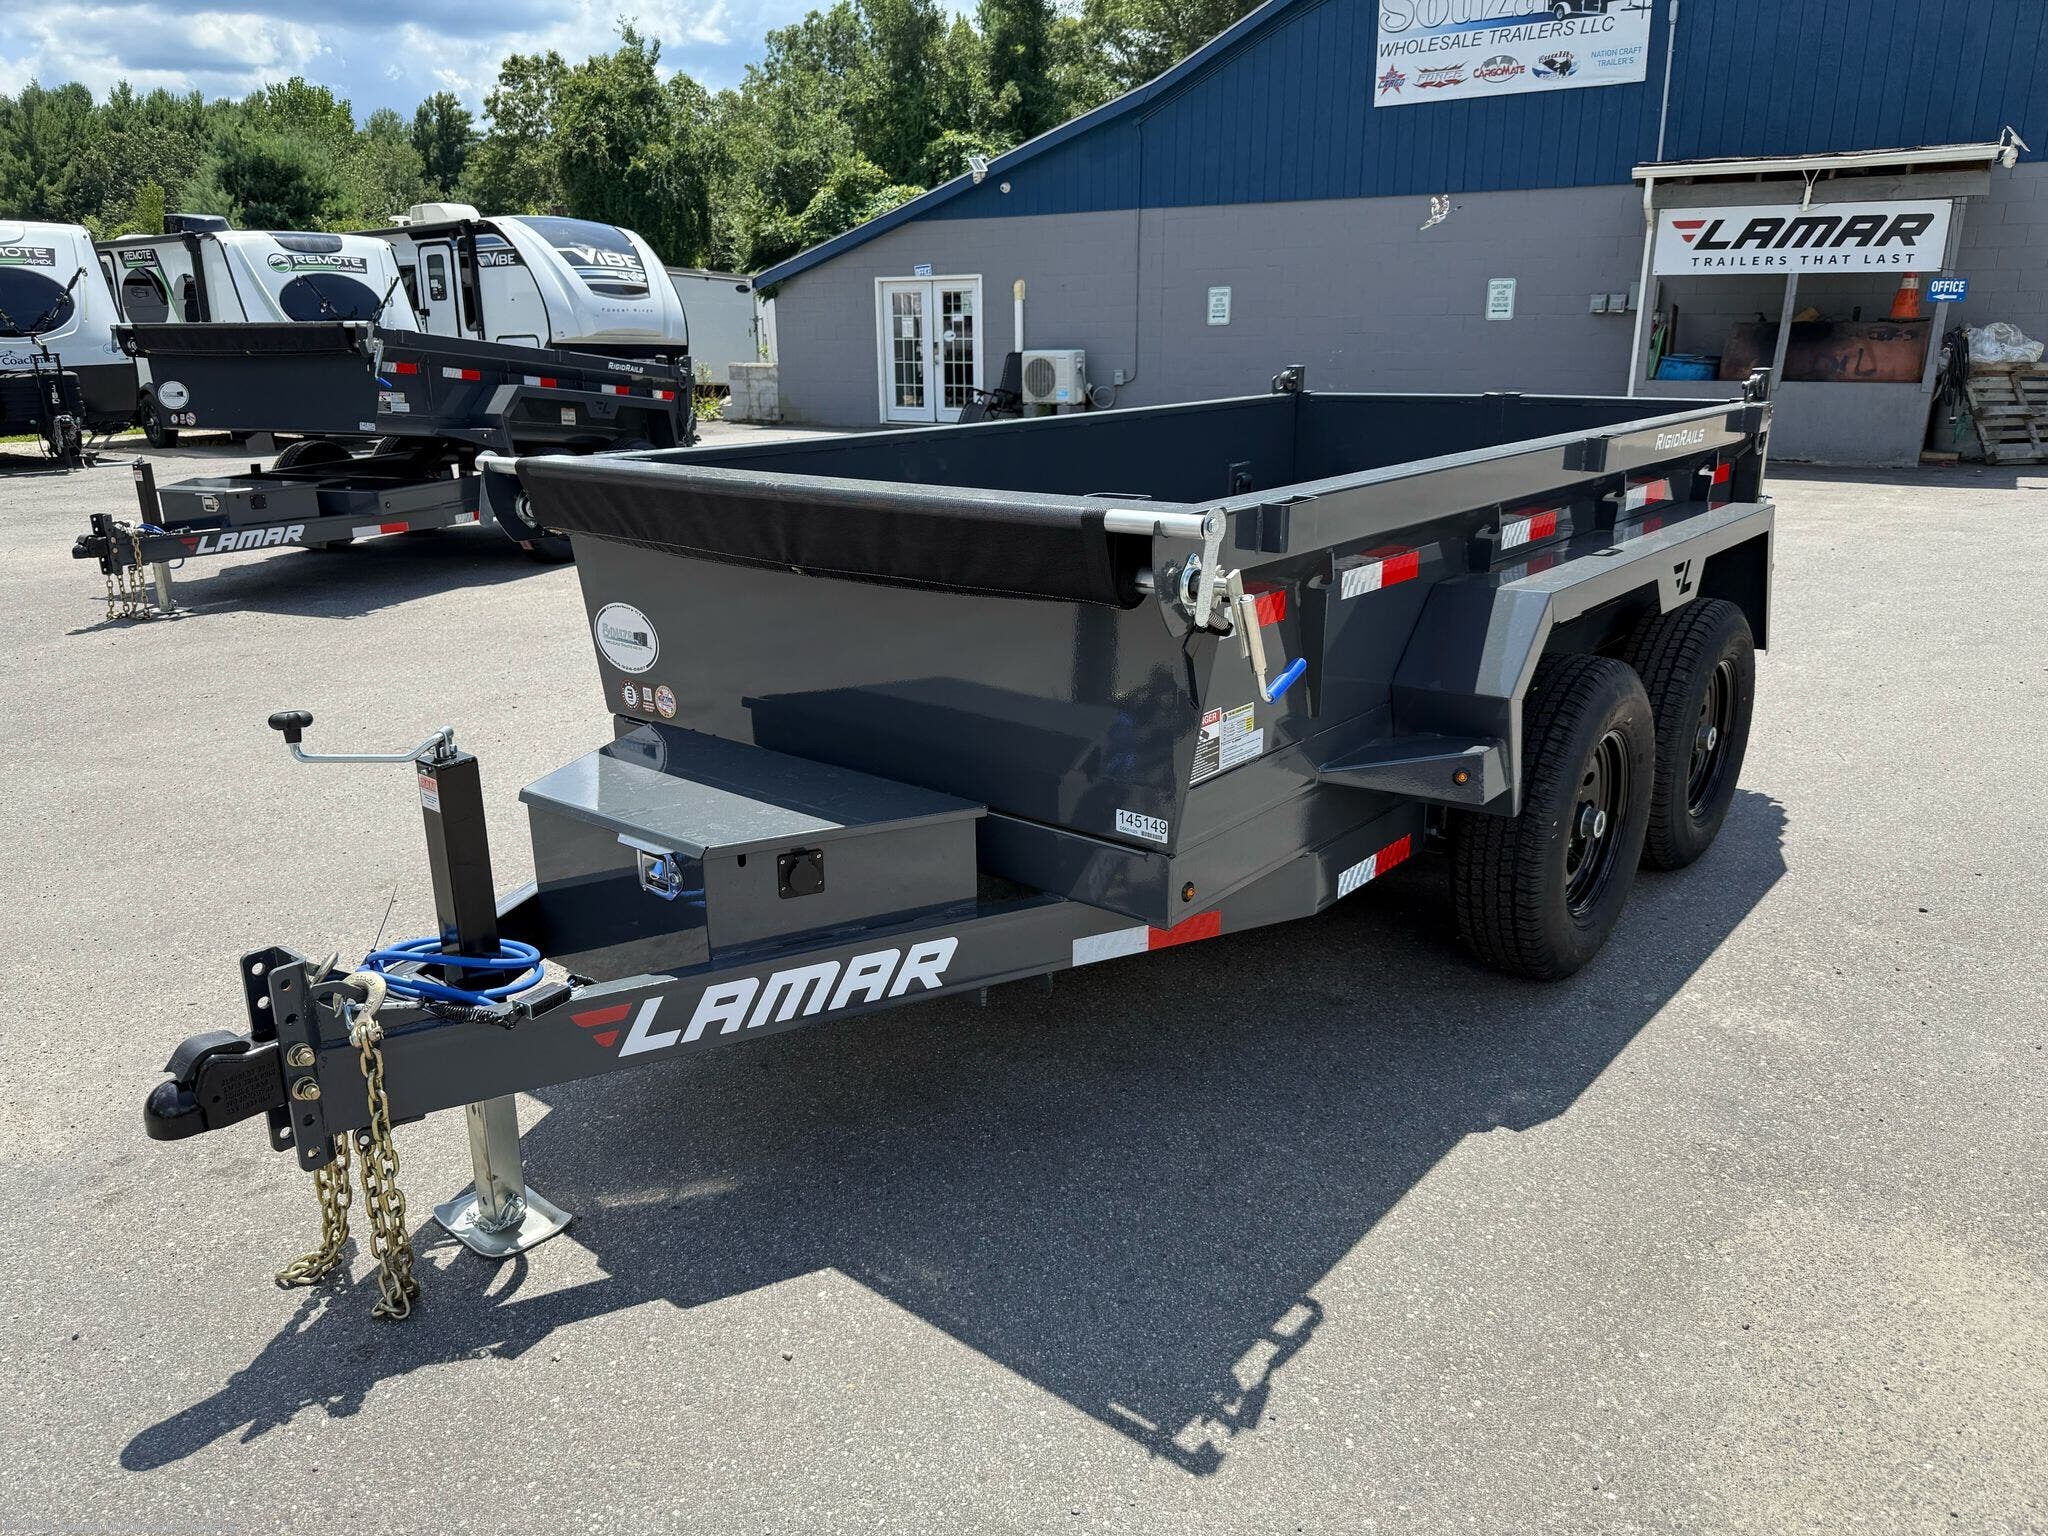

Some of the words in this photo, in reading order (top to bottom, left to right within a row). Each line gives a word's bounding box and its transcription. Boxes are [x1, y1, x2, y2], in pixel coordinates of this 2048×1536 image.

[1380, 31, 1484, 58] WHOLESALE
[1489, 20, 1576, 45] TRAILERS
[1580, 16, 1615, 34] LLC
[1591, 49, 1617, 58] NATION
[1619, 46, 1642, 55] CRAFT
[1692, 213, 1934, 251] LAMAR
[123, 250, 153, 261] REMOTE
[292, 255, 363, 267] REMOTE
[1691, 255, 1788, 267] TRAILERS
[1801, 254, 1851, 265] THAT
[1863, 253, 1916, 265] LAST
[1931, 280, 1966, 293] OFFICE
[196, 524, 305, 555] LAMAR
[1119, 811, 1167, 835] 145149
[618, 936, 959, 1058] LAMAR
